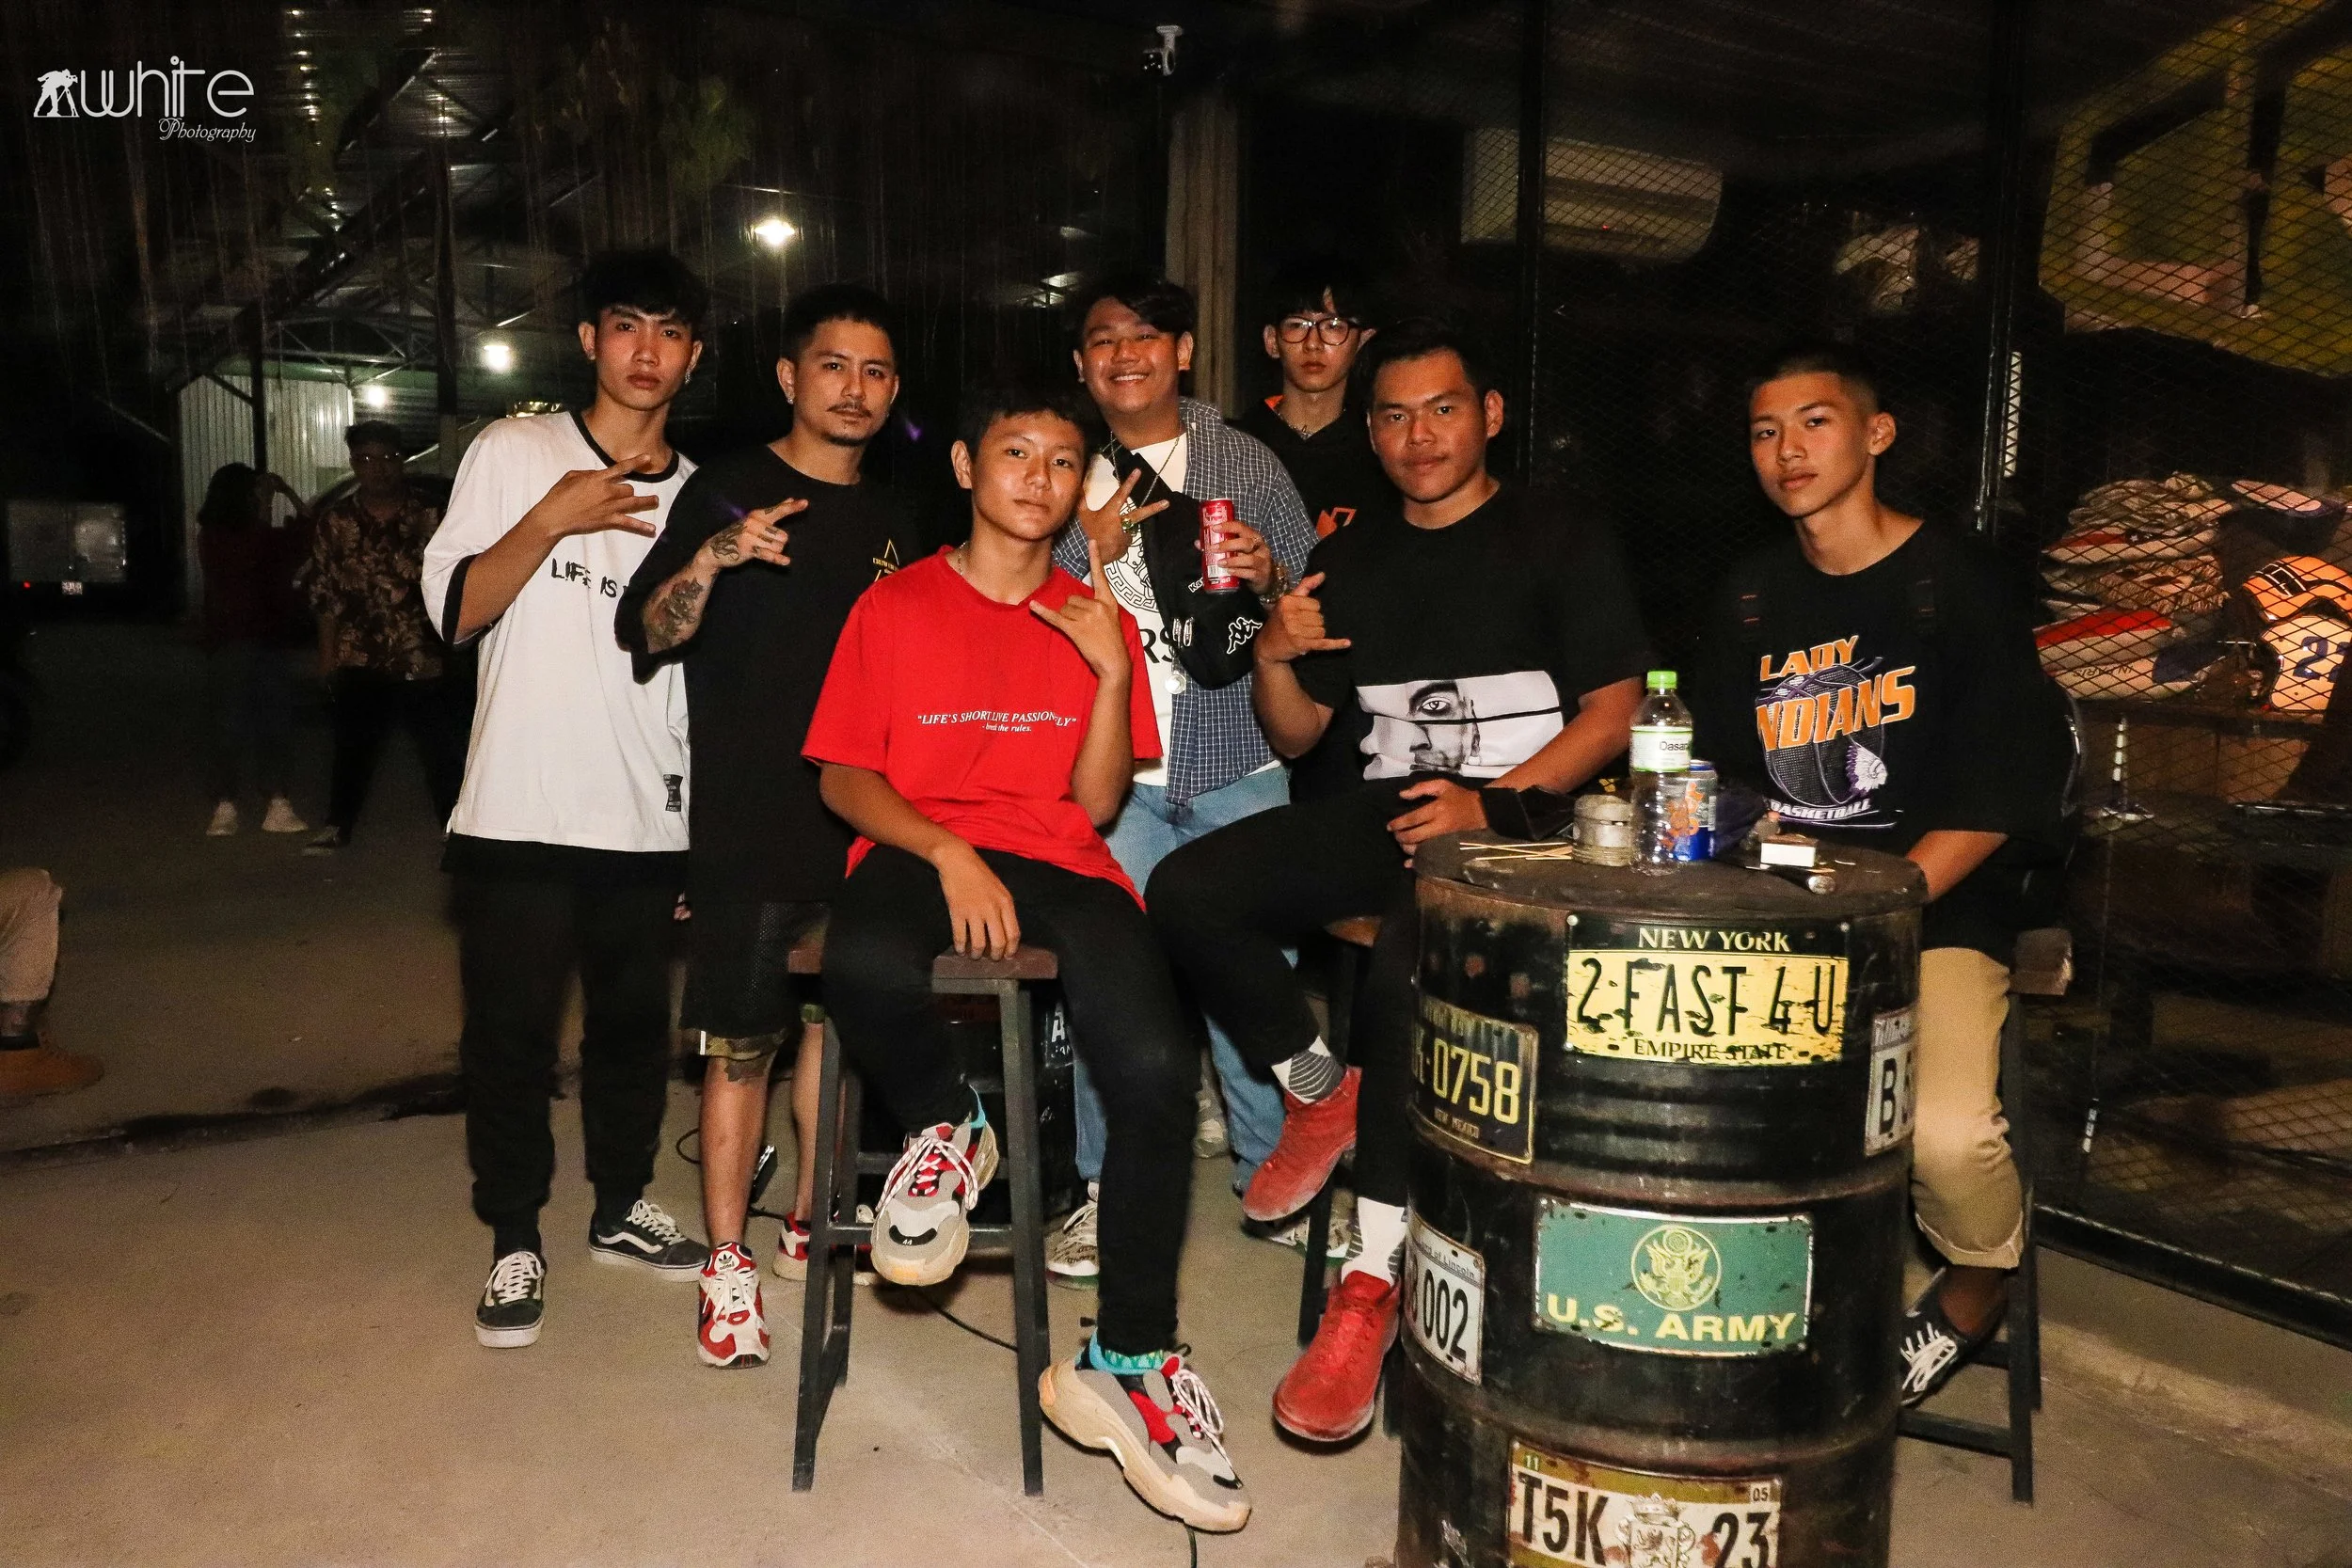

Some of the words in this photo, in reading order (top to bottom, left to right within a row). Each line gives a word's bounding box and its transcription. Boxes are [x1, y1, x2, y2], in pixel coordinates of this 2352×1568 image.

[599, 576, 618, 598] IS
[1760, 635, 1860, 682] LADY
[1769, 798, 1872, 820] BASKETBALL
[1638, 927, 1709, 950] NEW
[1718, 930, 1792, 953] YORK
[1577, 958, 1603, 1025] 2
[1623, 959, 1748, 1037] FAST
[1768, 966, 1792, 1035] 4
[1812, 964, 1836, 1035] U
[1634, 1037, 1719, 1060] EMPIRE
[1724, 1043, 1789, 1061] STATE
[1546, 1292, 1640, 1337] U.S.
[1654, 1312, 1797, 1342] ARMY
[1518, 1470, 1610, 1566] T5K
[1709, 1511, 1773, 1568] 23
